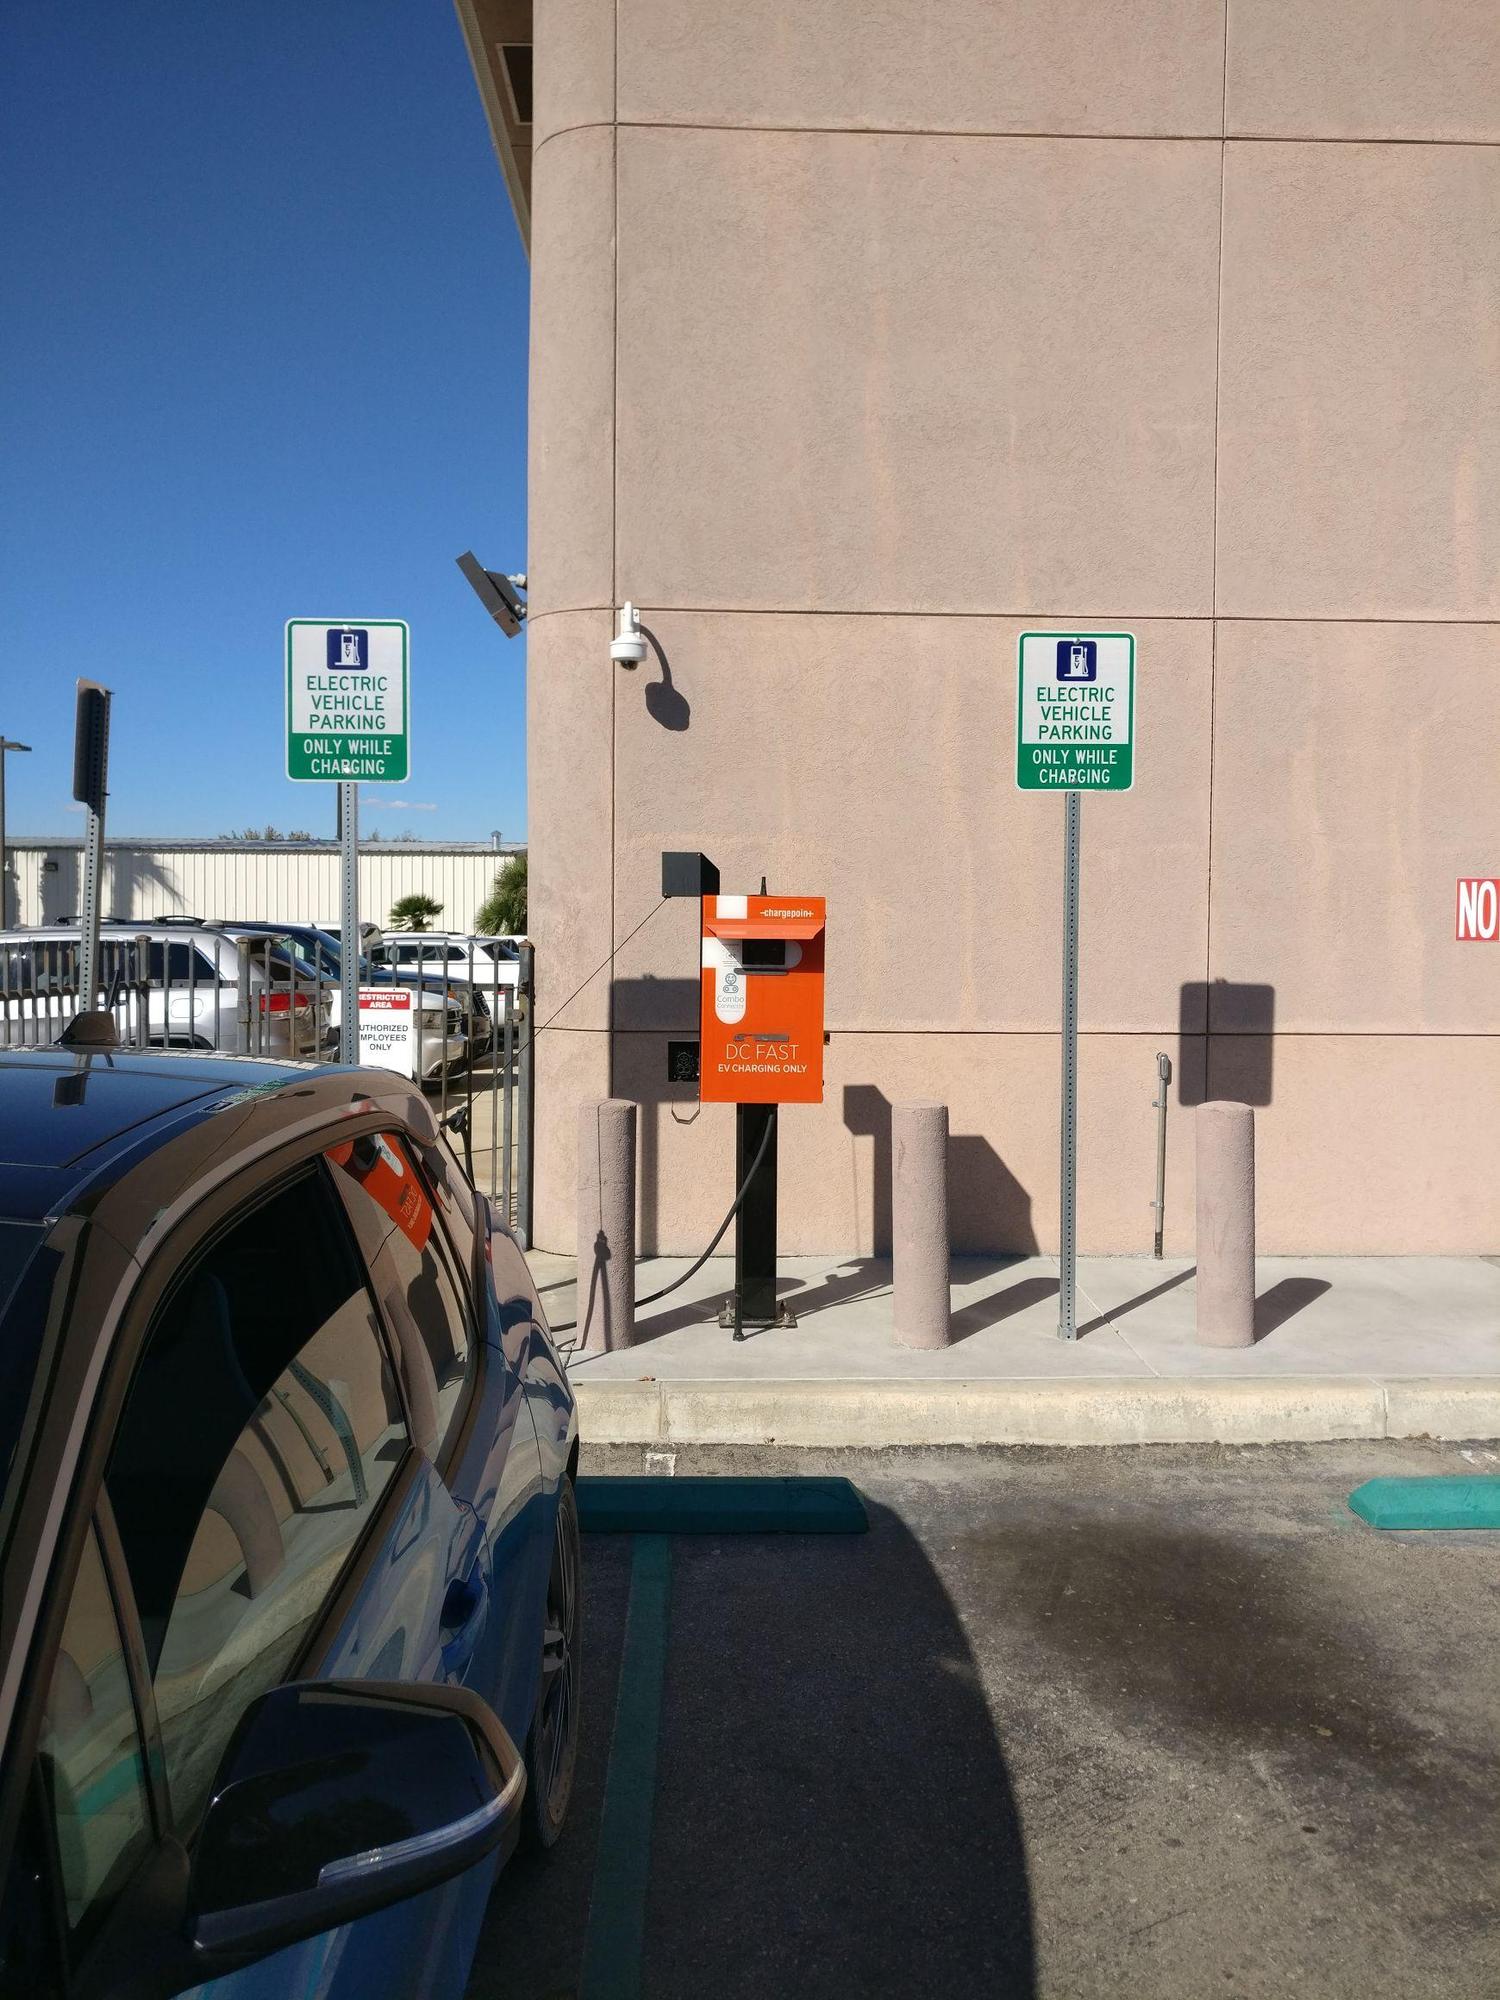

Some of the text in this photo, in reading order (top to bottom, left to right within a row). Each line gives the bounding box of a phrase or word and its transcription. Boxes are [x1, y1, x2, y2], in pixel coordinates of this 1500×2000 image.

[306, 675, 388, 692] ELECTRIC
[311, 694, 385, 711] VEHICLE
[1037, 686, 1115, 703] ELECTRIC
[1040, 705, 1112, 721] VEHICLE
[309, 714, 386, 730] PARKING
[1038, 724, 1113, 740] PARKING
[303, 738, 392, 755] ONLY WHILE
[1032, 749, 1118, 765] ONLY WHILE
[310, 758, 385, 775] CHARGING
[1039, 768, 1111, 784] CHARGING
[1458, 880, 1497, 939] NO
[716, 995, 745, 1003] Combo
[359, 1024, 408, 1032] UTHORIZED
[360, 1034, 407, 1042] MPLOYEES
[369, 1043, 392, 1051] ONLY
[726, 1043, 800, 1060] DC FAST
[718, 1063, 807, 1073] EV CHARGING ONLY
